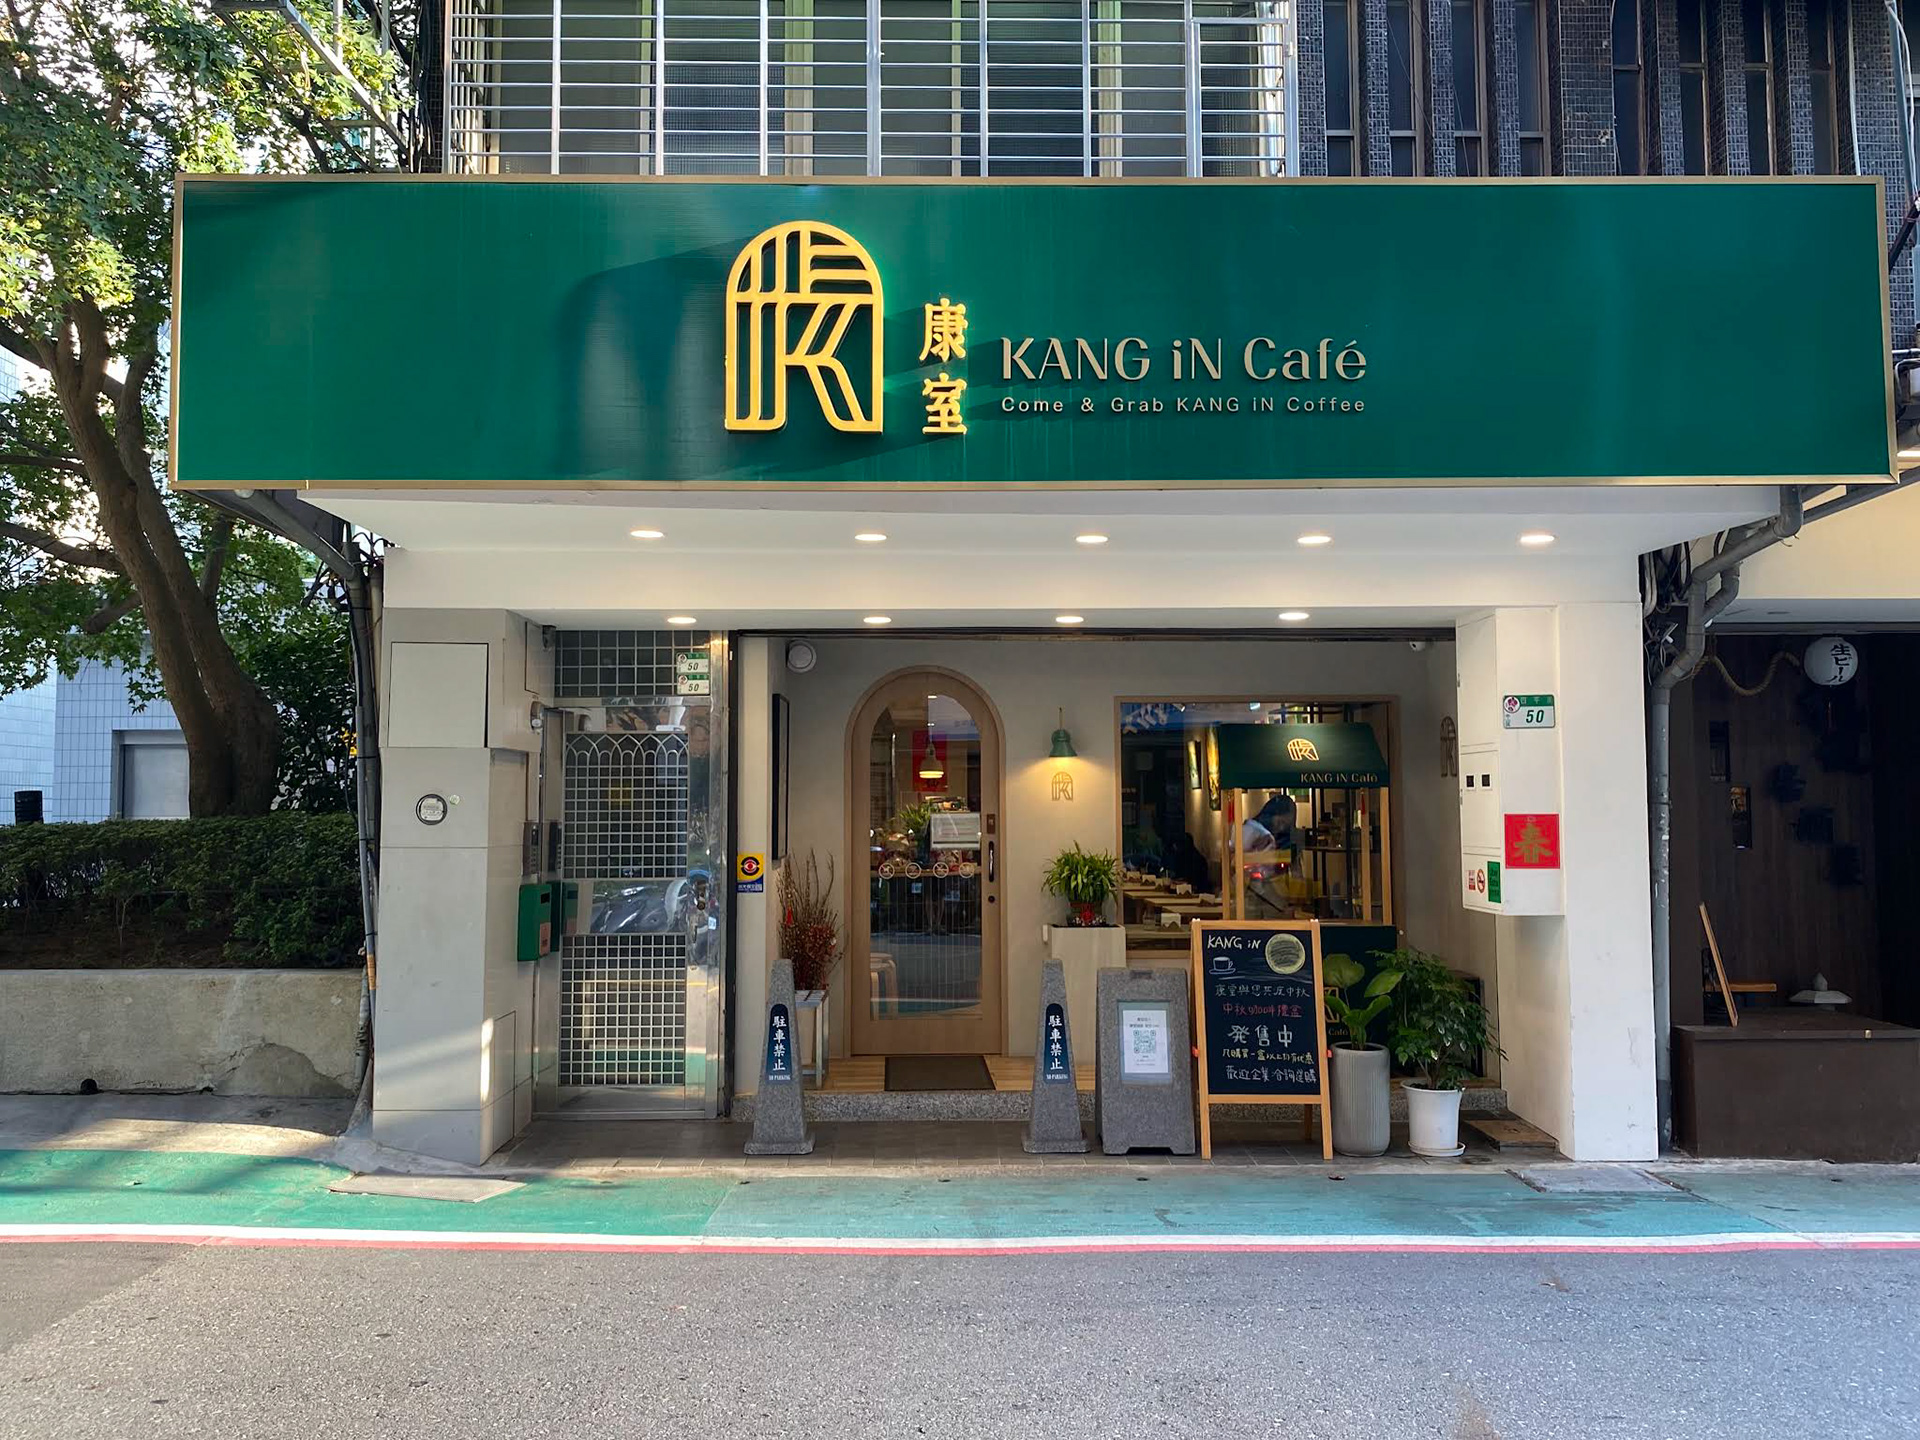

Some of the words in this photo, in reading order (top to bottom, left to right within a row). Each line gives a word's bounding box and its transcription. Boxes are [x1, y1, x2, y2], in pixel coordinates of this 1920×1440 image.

[919, 297, 969, 434] 康室
[1000, 337, 1150, 380] KANG
[1172, 338, 1221, 380] iN
[1243, 337, 1367, 380] Café
[1001, 397, 1064, 412] Come
[1080, 397, 1094, 412] &
[1111, 397, 1164, 412] Grab
[1177, 397, 1239, 412] KANG
[1253, 397, 1274, 411] iN
[1287, 397, 1365, 412] Coffee
[687, 662, 699, 671] 50
[1828, 643, 1852, 682] 生ビール
[688, 683, 700, 692] 50
[1526, 709, 1545, 723] 50
[1300, 773, 1332, 783] KANG
[1514, 823, 1553, 863] 春
[1207, 935, 1242, 949] KANG
[772, 1015, 787, 1071] 駐車禁止
[1048, 1014, 1064, 1071] 駐車禁止
